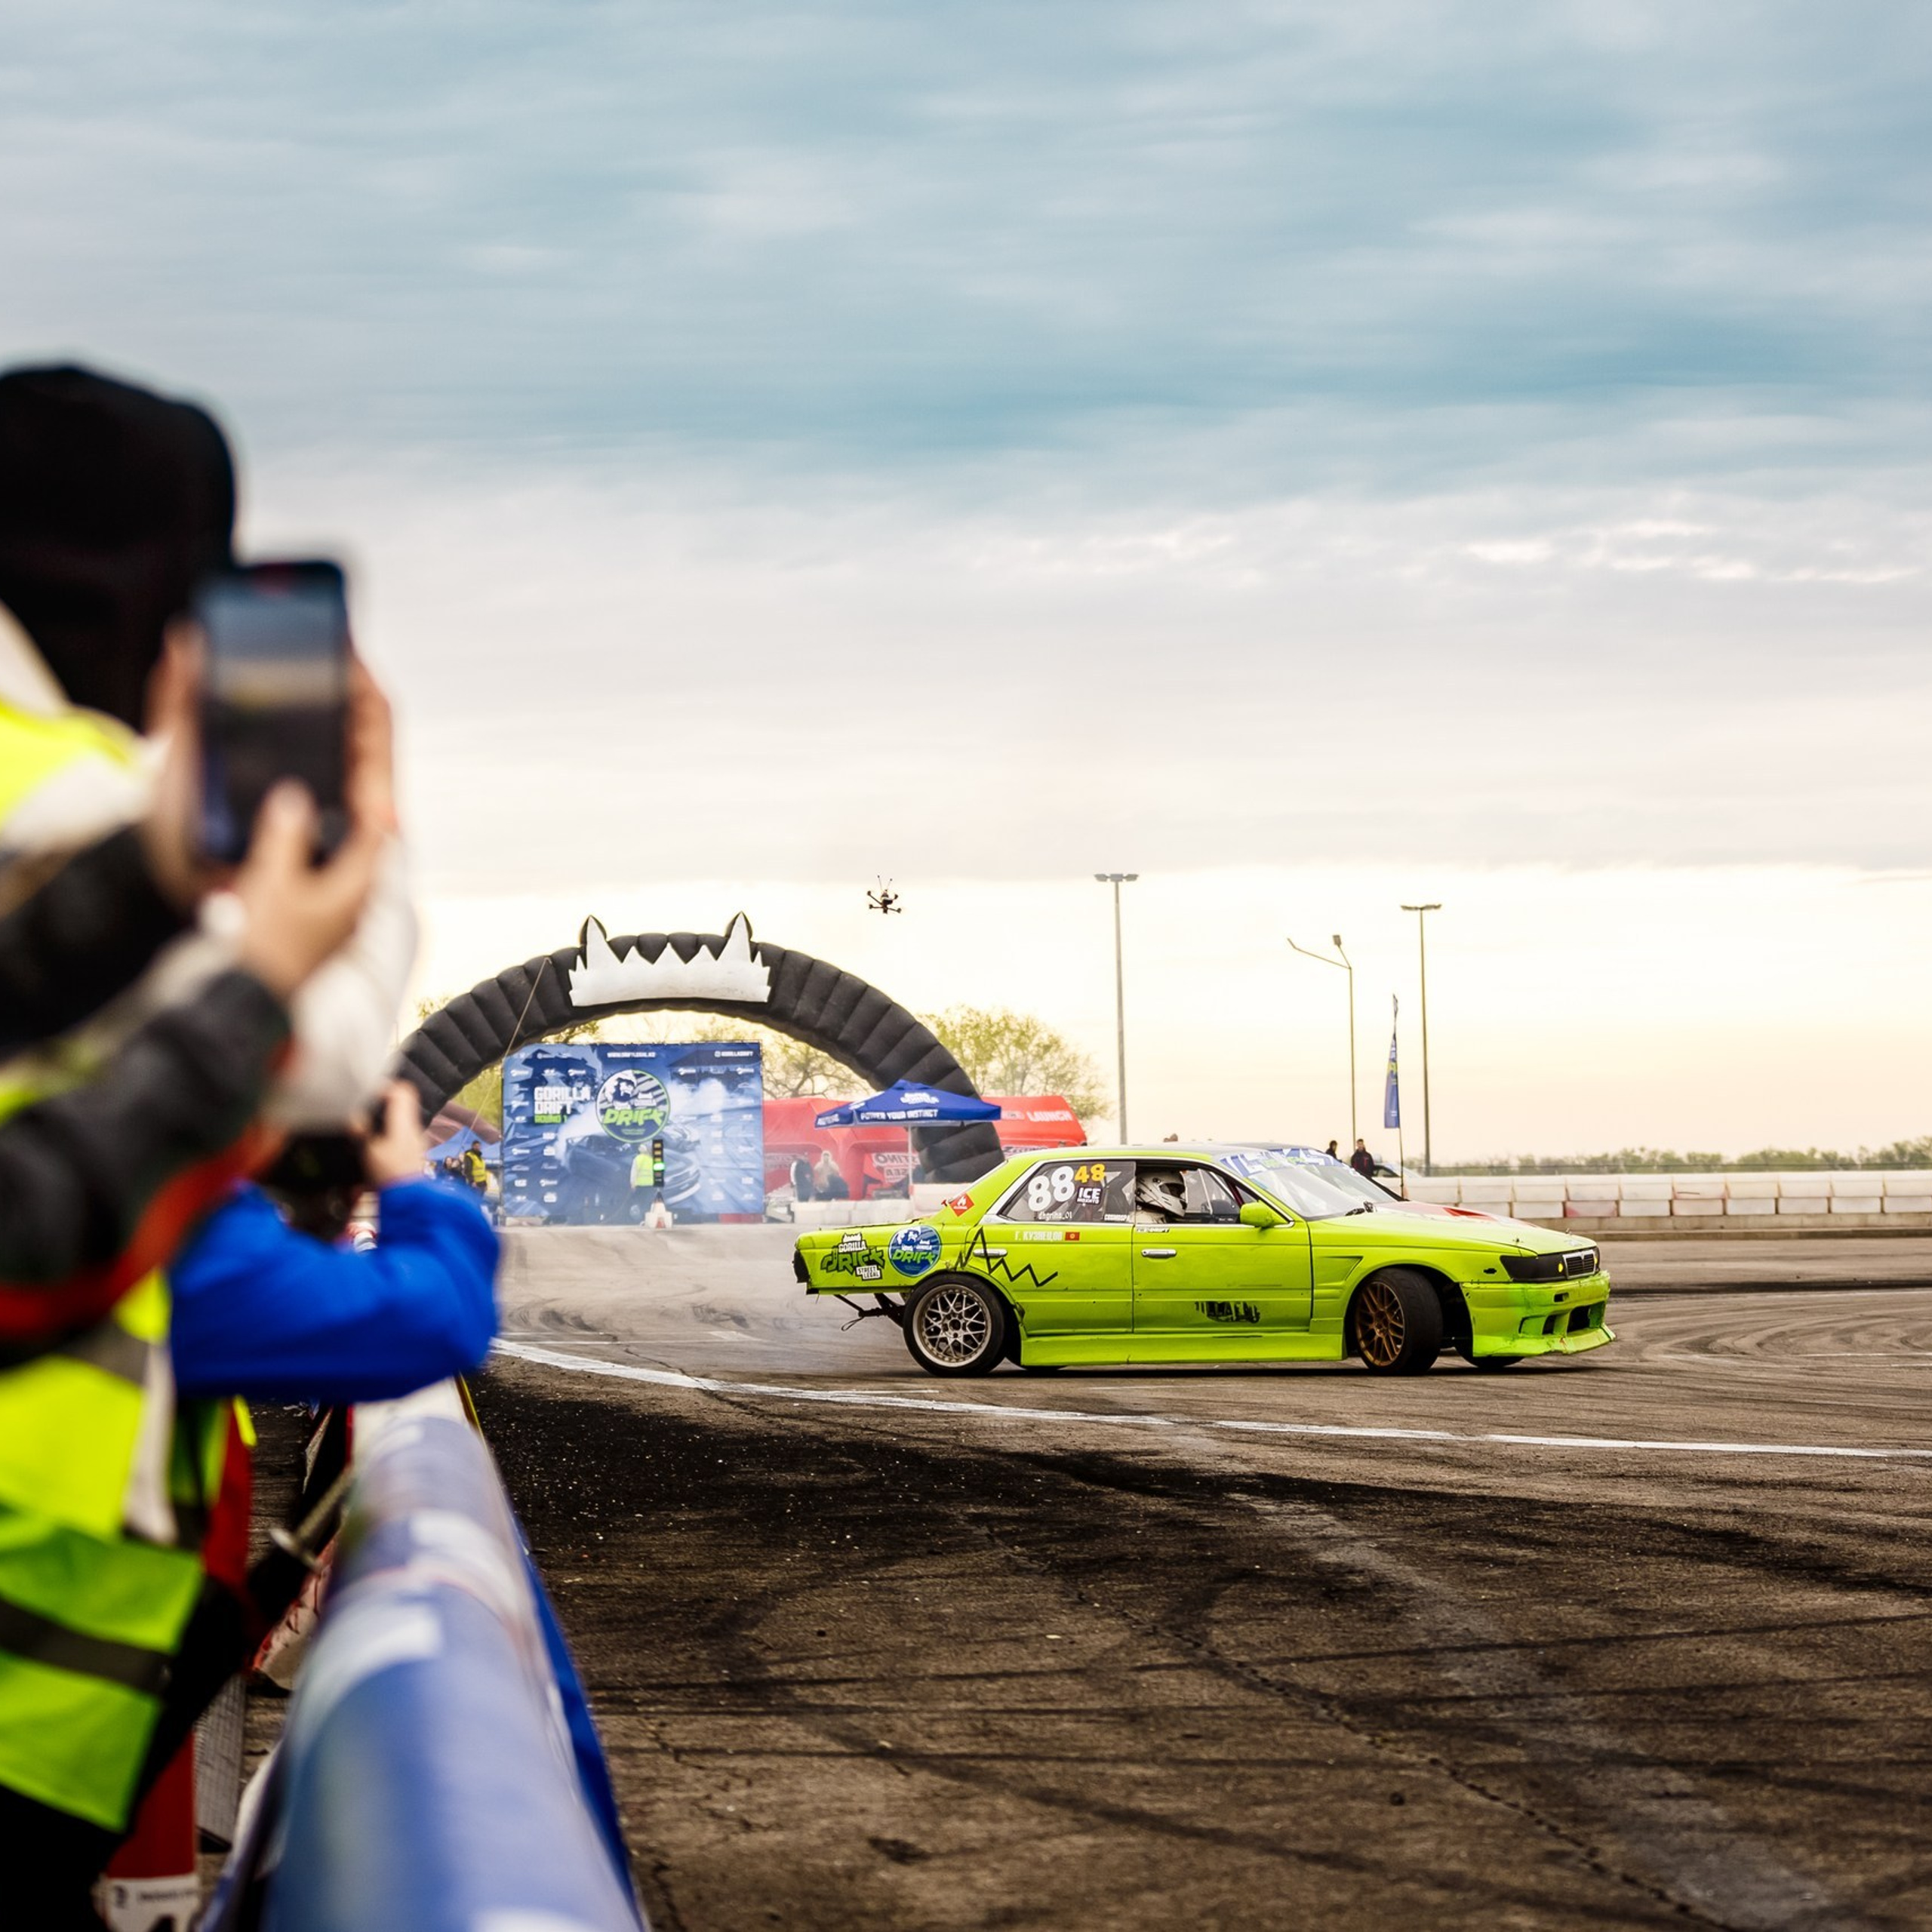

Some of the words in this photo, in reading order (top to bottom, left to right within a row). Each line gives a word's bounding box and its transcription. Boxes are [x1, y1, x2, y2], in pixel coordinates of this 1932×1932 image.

[603, 1108, 664, 1127] DRIFT
[860, 1111, 886, 1121] POWER
[887, 1111, 906, 1120] YOUR
[907, 1109, 939, 1118] INSTINCT
[1074, 1164, 1105, 1183] 48
[1028, 1166, 1075, 1211] 88
[1078, 1187, 1101, 1200] ICE
[838, 1240, 867, 1253] GORILLA
[821, 1247, 884, 1274] DRIFT
[892, 1250, 936, 1266] DRIFT
